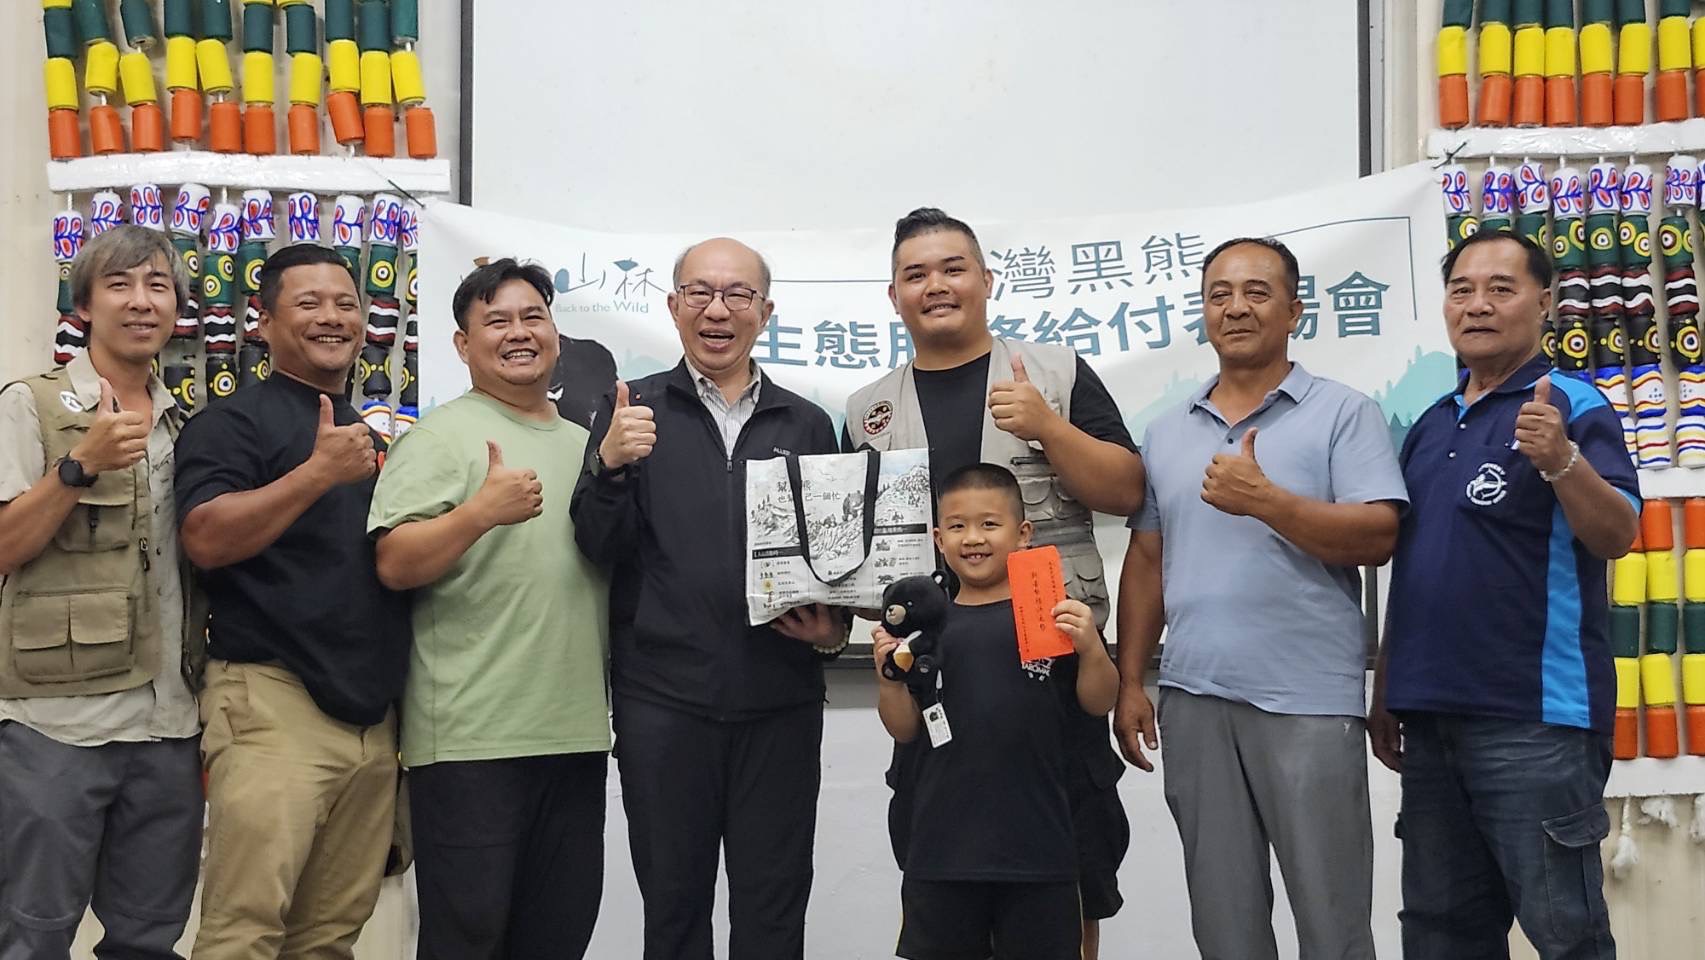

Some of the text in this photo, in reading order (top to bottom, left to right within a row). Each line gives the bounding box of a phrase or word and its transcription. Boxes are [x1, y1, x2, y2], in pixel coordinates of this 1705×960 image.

[555, 300, 649, 314] Back to the Wild
